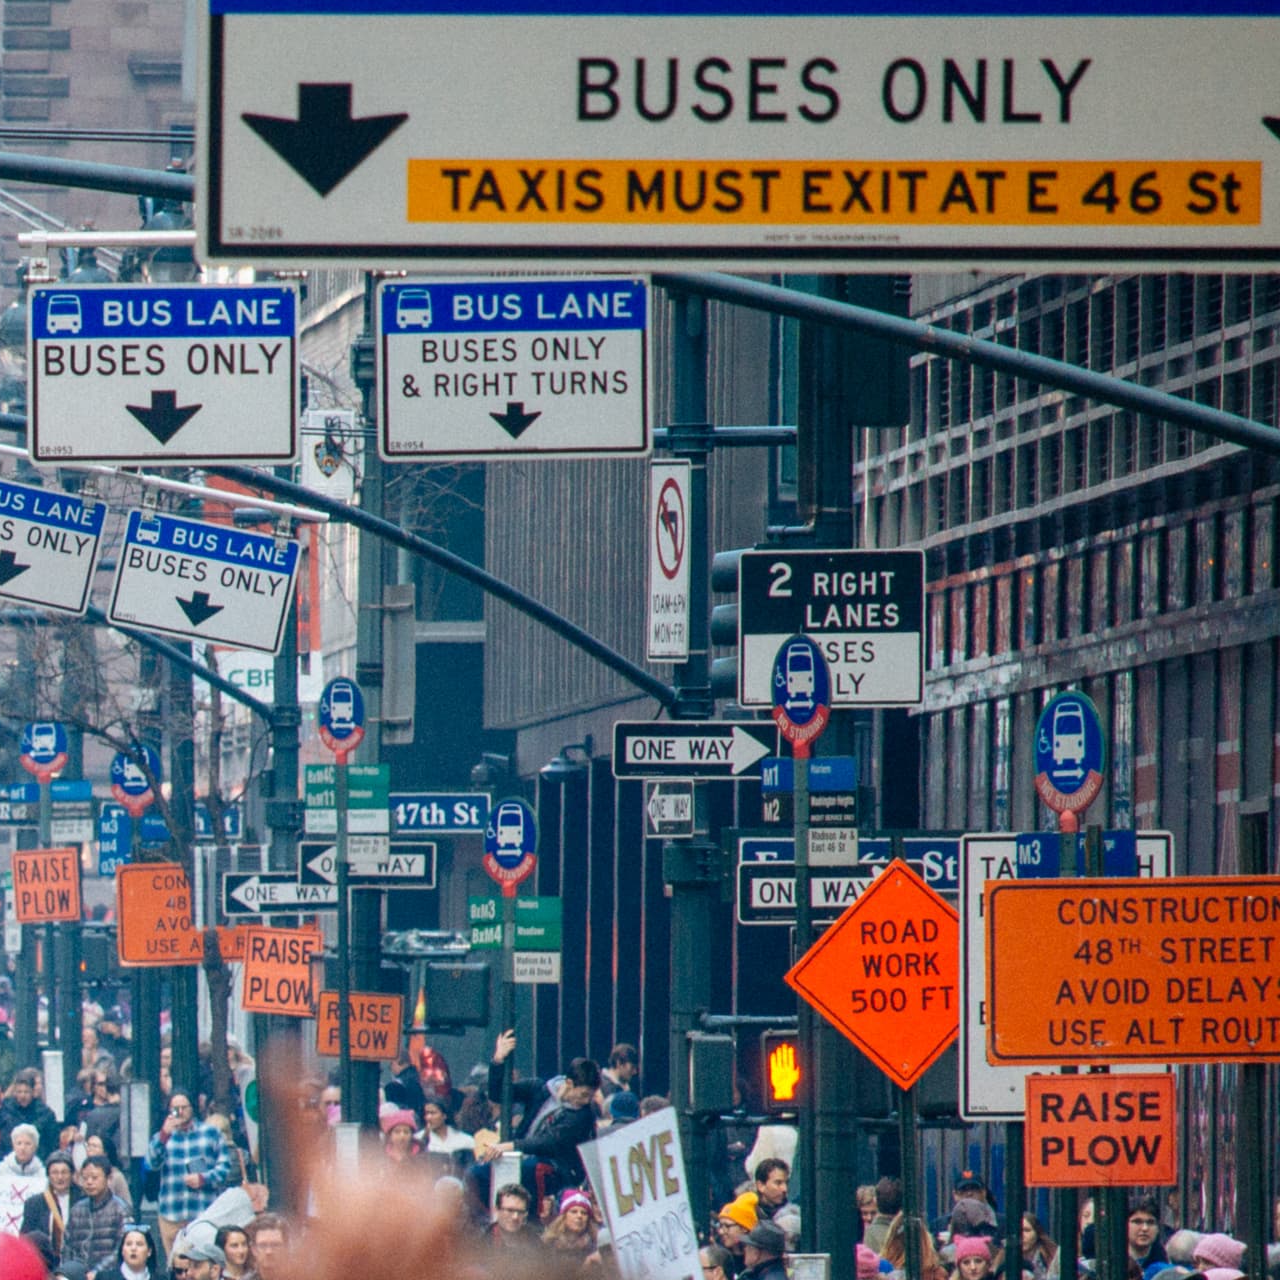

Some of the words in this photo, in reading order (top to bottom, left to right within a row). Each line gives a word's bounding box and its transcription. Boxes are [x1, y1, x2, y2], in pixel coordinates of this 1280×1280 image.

[576, 57, 841, 123] BUSES
[881, 58, 1093, 124] ONLY
[440, 169, 605, 213] TAXIS
[627, 169, 781, 213] MUST
[802, 170, 928, 214] EXIT
[939, 170, 1007, 214] AT
[1028, 171, 1058, 213] E
[1082, 171, 1163, 214] 46
[1186, 172, 1242, 214] St
[103, 300, 172, 326] BUS
[187, 299, 281, 325] LANE
[453, 295, 522, 321] BUS
[537, 292, 632, 319] LANE
[44, 344, 166, 376] BUSES
[188, 342, 282, 375] ONLY
[422, 339, 517, 363] BUSES
[532, 337, 606, 361] ONLY
[402, 374, 421, 397] &
[434, 372, 517, 397] RIGHT
[532, 370, 628, 395] TURNS
[33, 498, 95, 527] LANE
[27, 526, 90, 557] ONLY
[172, 527, 218, 551] BUS
[225, 538, 288, 566] LANE
[128, 547, 208, 582] BUSES
[220, 566, 283, 597] ONLY
[769, 562, 792, 597] 2
[813, 571, 895, 596] RIGHT
[806, 603, 900, 628] LANES
[653, 623, 684, 643] MON-FRI
[826, 641, 875, 663] SES
[836, 673, 865, 695] LY
[632, 740, 676, 760] ONE
[689, 740, 734, 760] WAY
[763, 765, 778, 786] M1
[395, 803, 446, 825] 47th
[454, 803, 479, 825] St
[651, 801, 665, 818] ONE
[674, 801, 689, 818] WAY
[764, 799, 780, 821] M2
[101, 819, 118, 833] M3
[923, 851, 958, 881] St
[1019, 840, 1041, 865] M3
[17, 857, 71, 884] RAISE
[21, 889, 71, 917] PLOW
[244, 887, 278, 901] ONE
[296, 886, 331, 901] WAY
[759, 882, 795, 903] ON
[472, 924, 503, 944] BxM4
[861, 919, 939, 945] ROAD
[146, 939, 179, 953] USE
[251, 937, 314, 965] RAISE
[1160, 936, 1275, 963] STREET
[862, 952, 940, 978] WORK
[249, 977, 312, 1006] PLOW
[852, 988, 907, 1013] 500
[922, 986, 954, 1010] FT
[1056, 978, 1149, 1005] AVOID
[1049, 1020, 1105, 1046] USE
[1125, 1017, 1184, 1045] ALT
[1201, 1017, 1280, 1044] ROUT
[1041, 1091, 1161, 1123] RAISE
[1041, 1135, 1162, 1166] PLOW
[609, 1129, 680, 1218] LOVE
